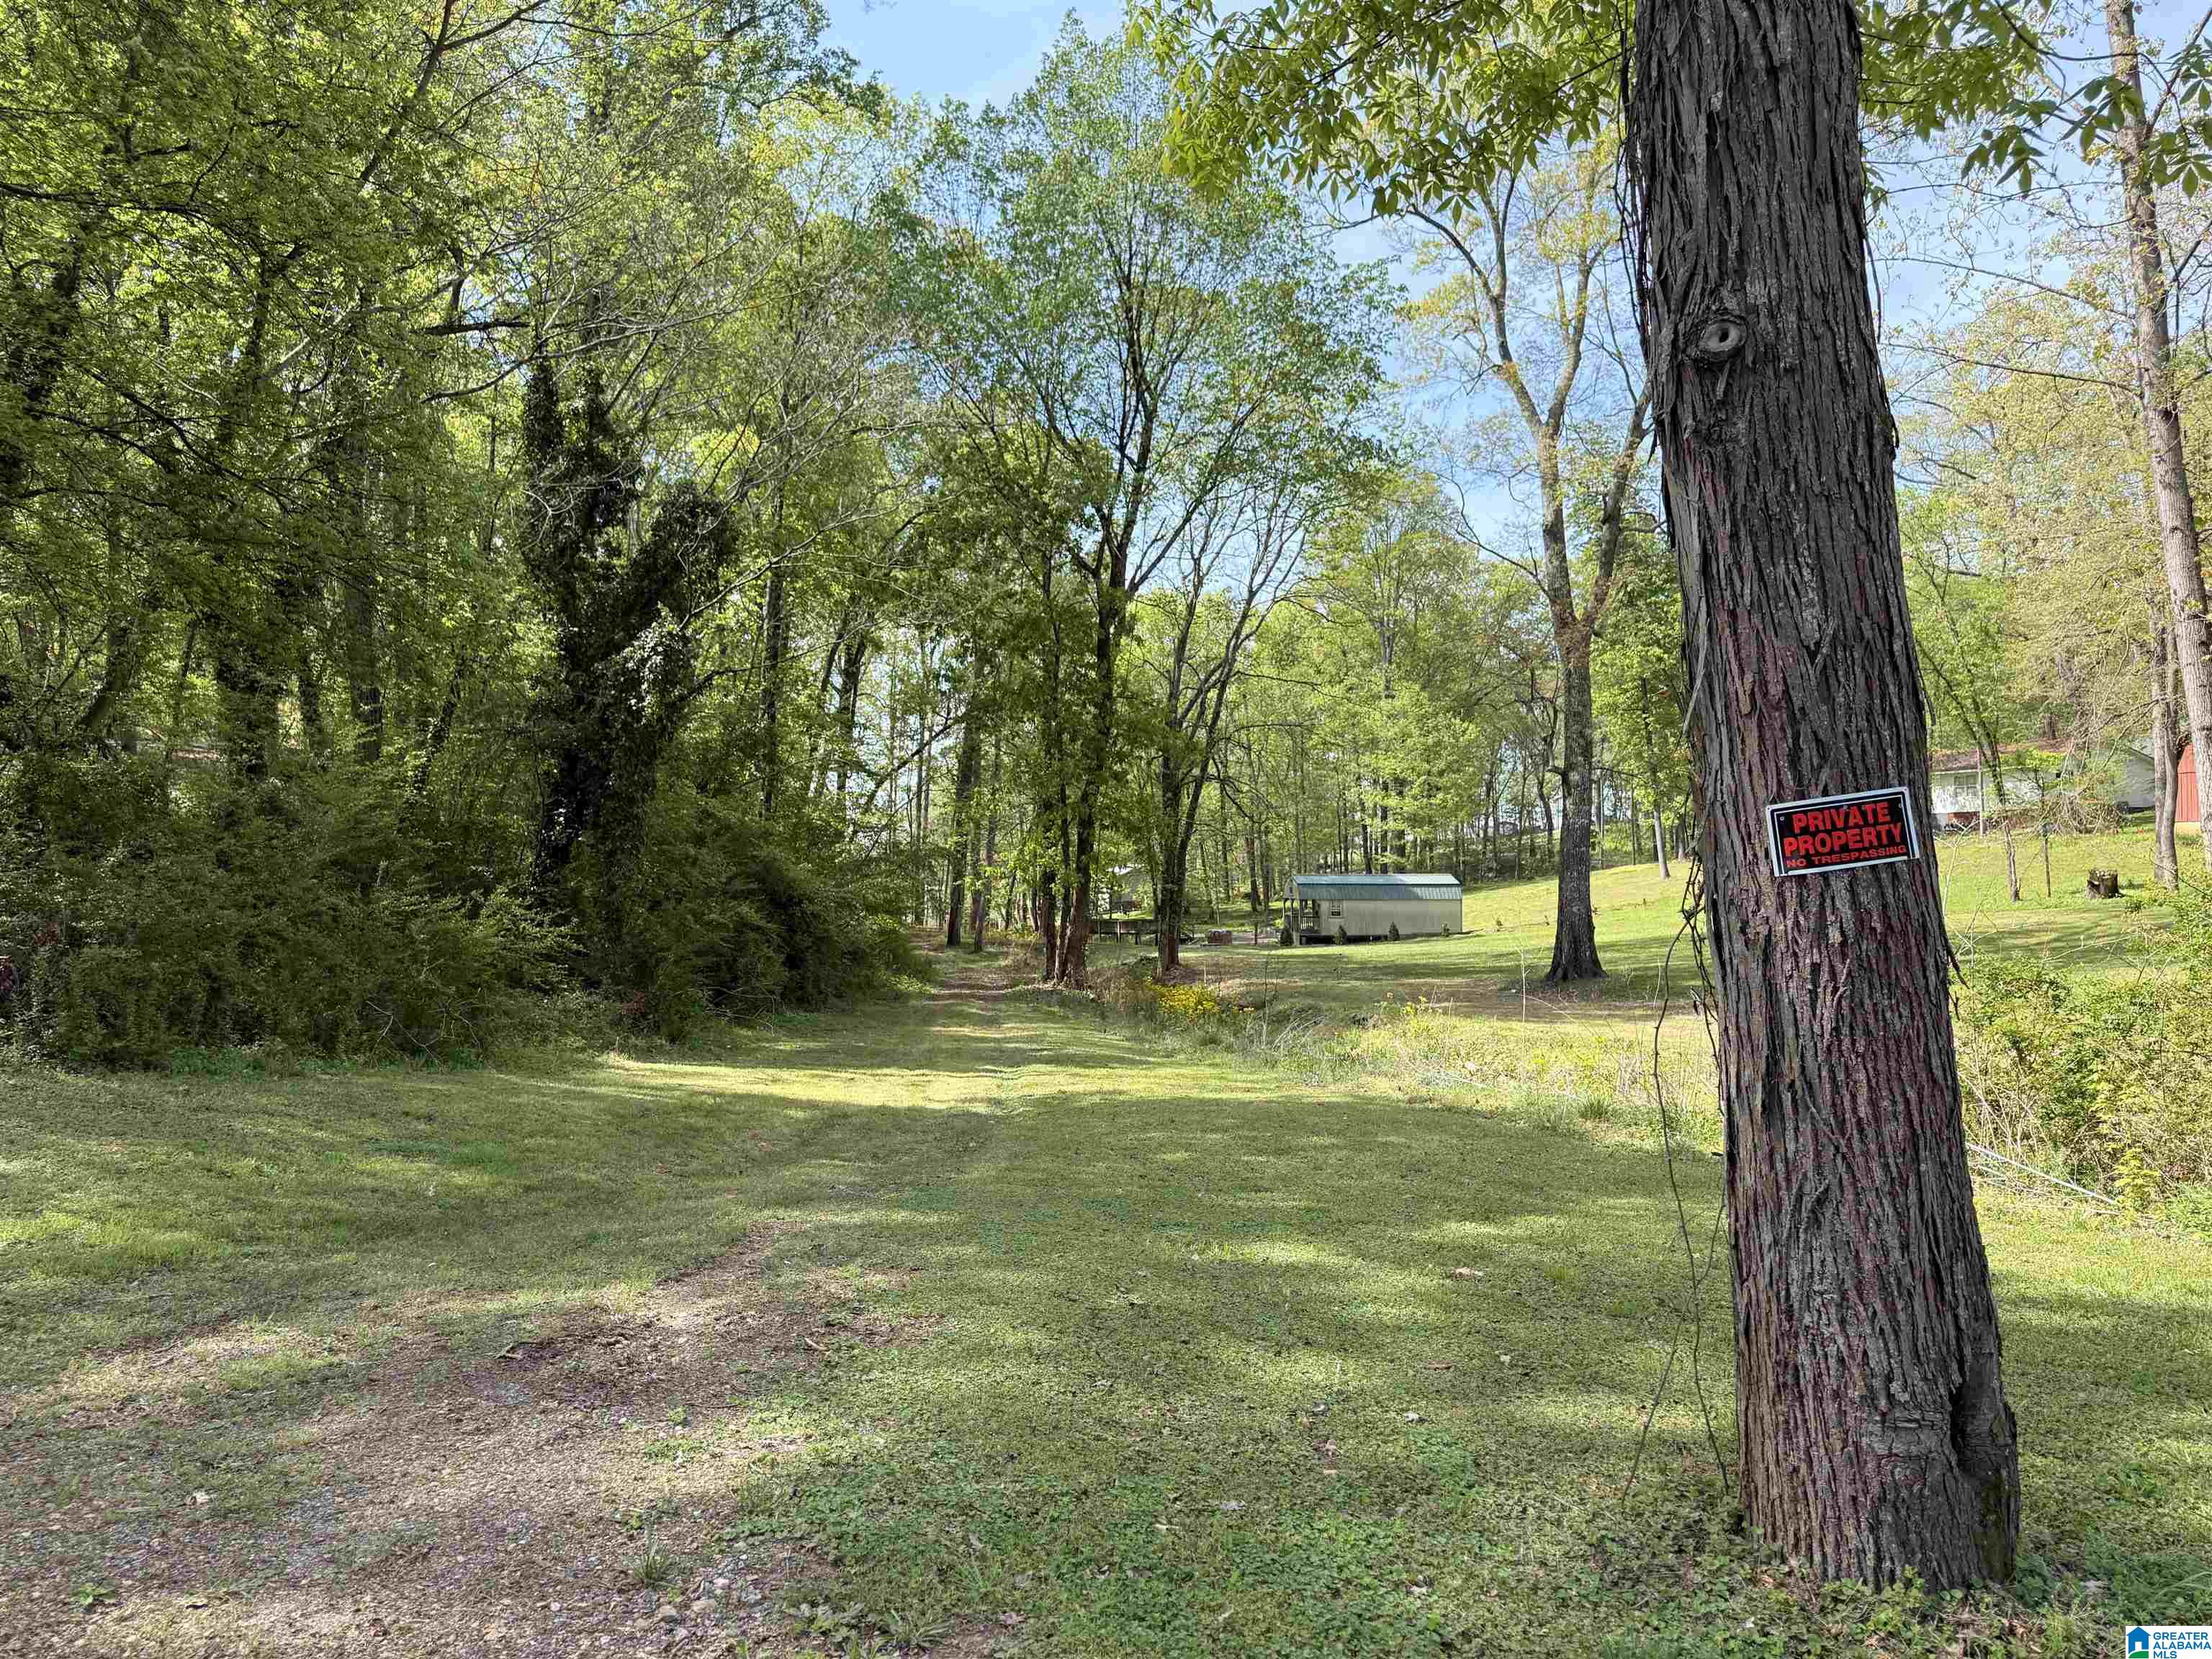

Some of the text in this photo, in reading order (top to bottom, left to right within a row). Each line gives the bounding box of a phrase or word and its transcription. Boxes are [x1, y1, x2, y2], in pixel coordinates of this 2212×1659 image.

[1792, 801, 1890, 834] PRIVATE
[1784, 822, 1902, 857] PROPERTY
[1785, 845, 1907, 868] NO TRESPASSING
